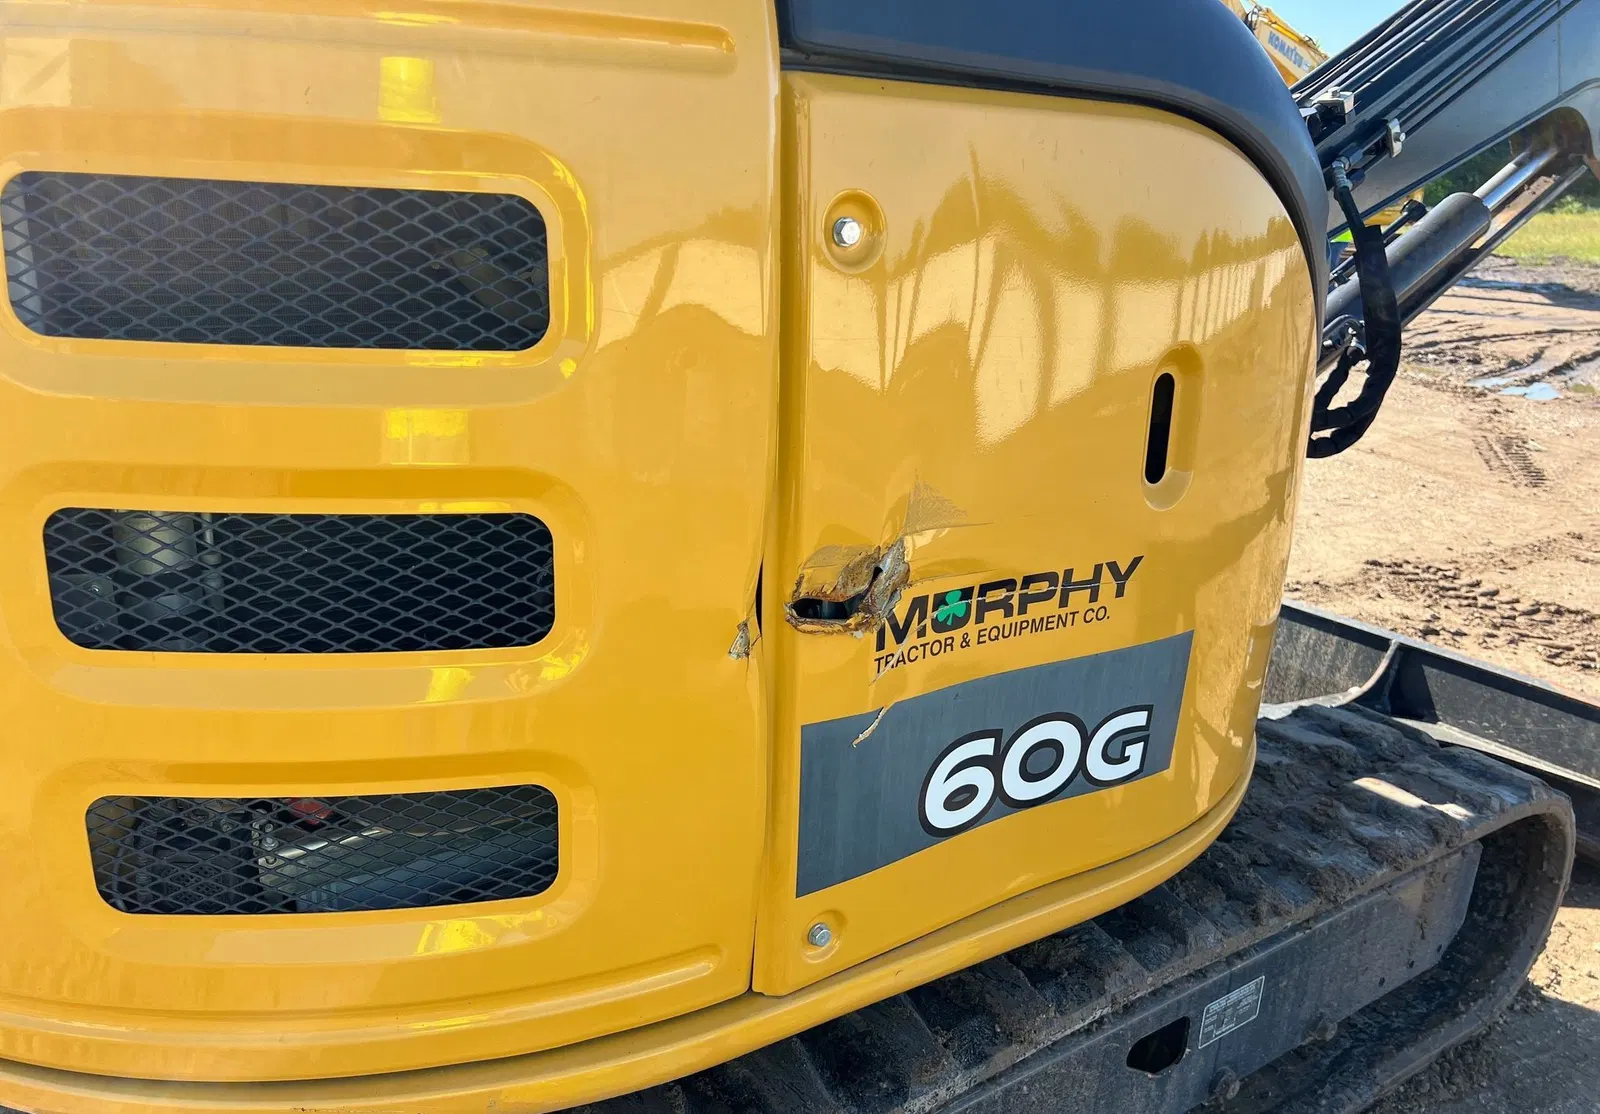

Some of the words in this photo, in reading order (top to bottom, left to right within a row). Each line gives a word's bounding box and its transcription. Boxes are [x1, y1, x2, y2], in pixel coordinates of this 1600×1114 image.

[1268, 31, 1304, 68] KOMATSU
[874, 636, 955, 674] TRACTOR
[959, 632, 971, 649] &
[976, 611, 1079, 645] EQUIPMENT
[1083, 605, 1110, 624] CO.
[919, 705, 1154, 837] 60G
